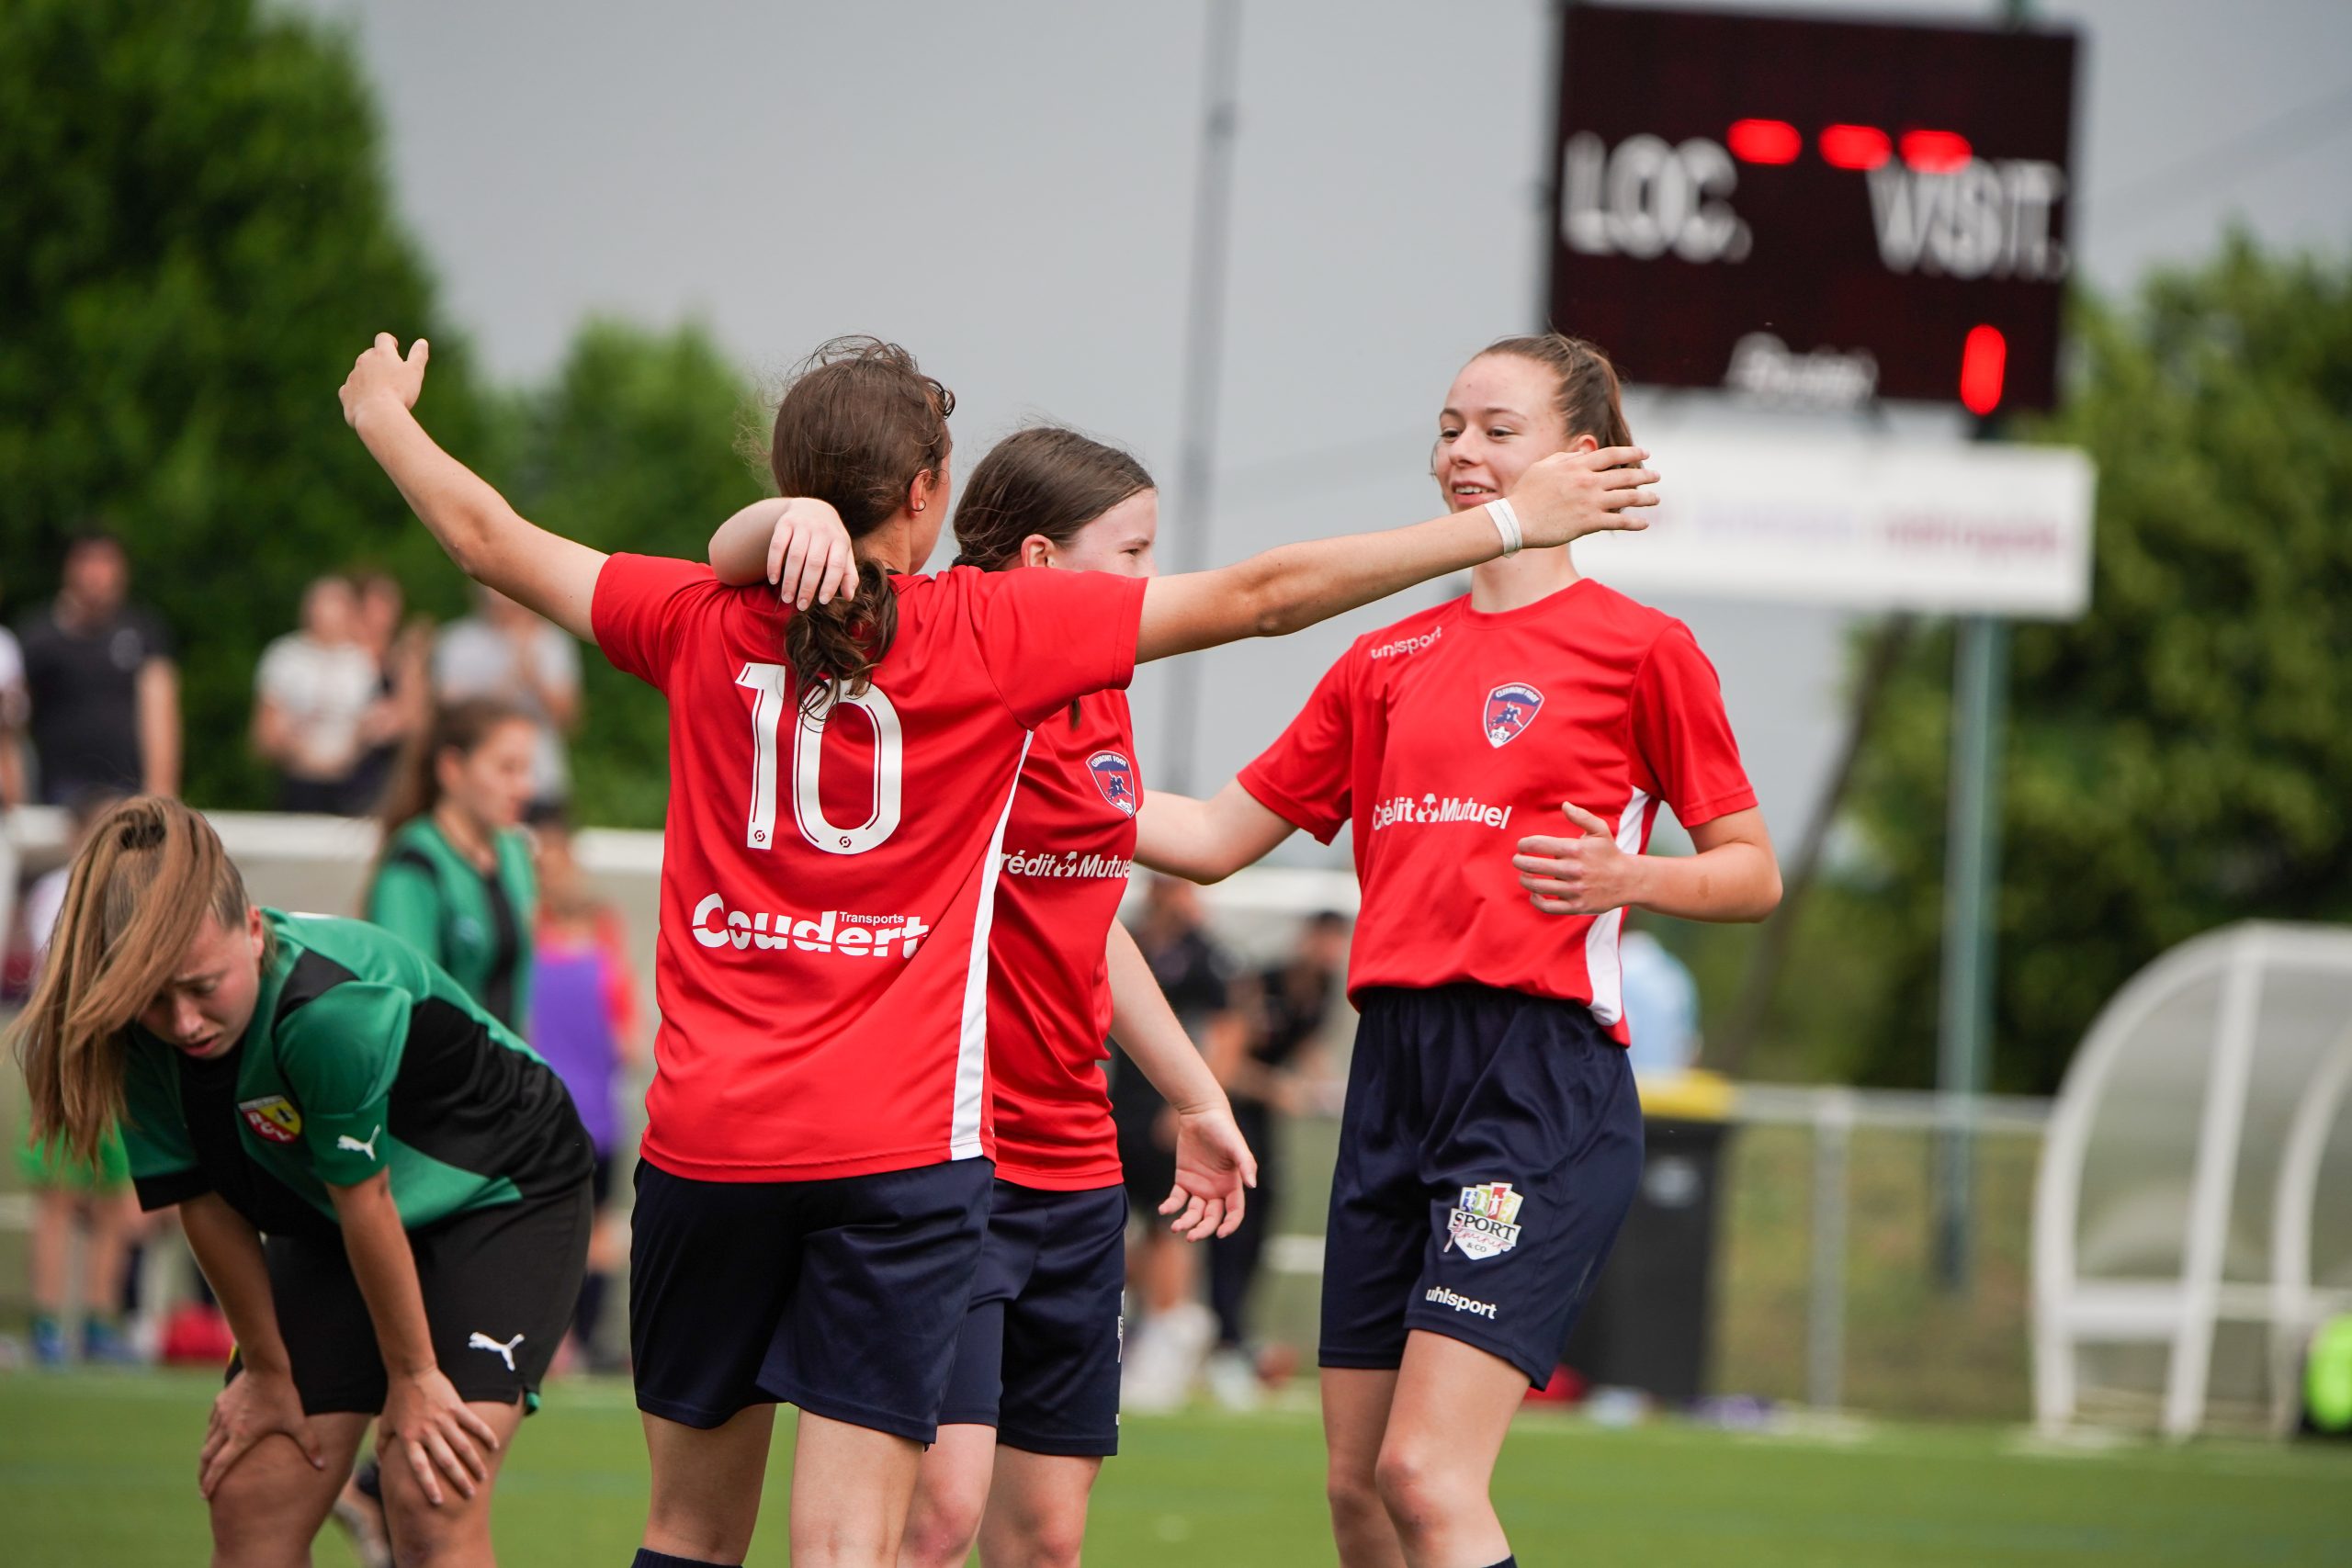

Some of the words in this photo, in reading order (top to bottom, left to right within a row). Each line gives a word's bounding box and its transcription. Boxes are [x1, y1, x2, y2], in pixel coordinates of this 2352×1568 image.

[735, 661, 903, 855] 10
[1439, 796, 1512, 829] Mutuel
[1000, 850, 1057, 876] rédit
[1077, 854, 1131, 878] Mutue
[692, 893, 930, 959] Coudert
[839, 911, 905, 926] Transports
[1453, 1213, 1516, 1241] SPORT
[1425, 1286, 1498, 1320] uhlsport
